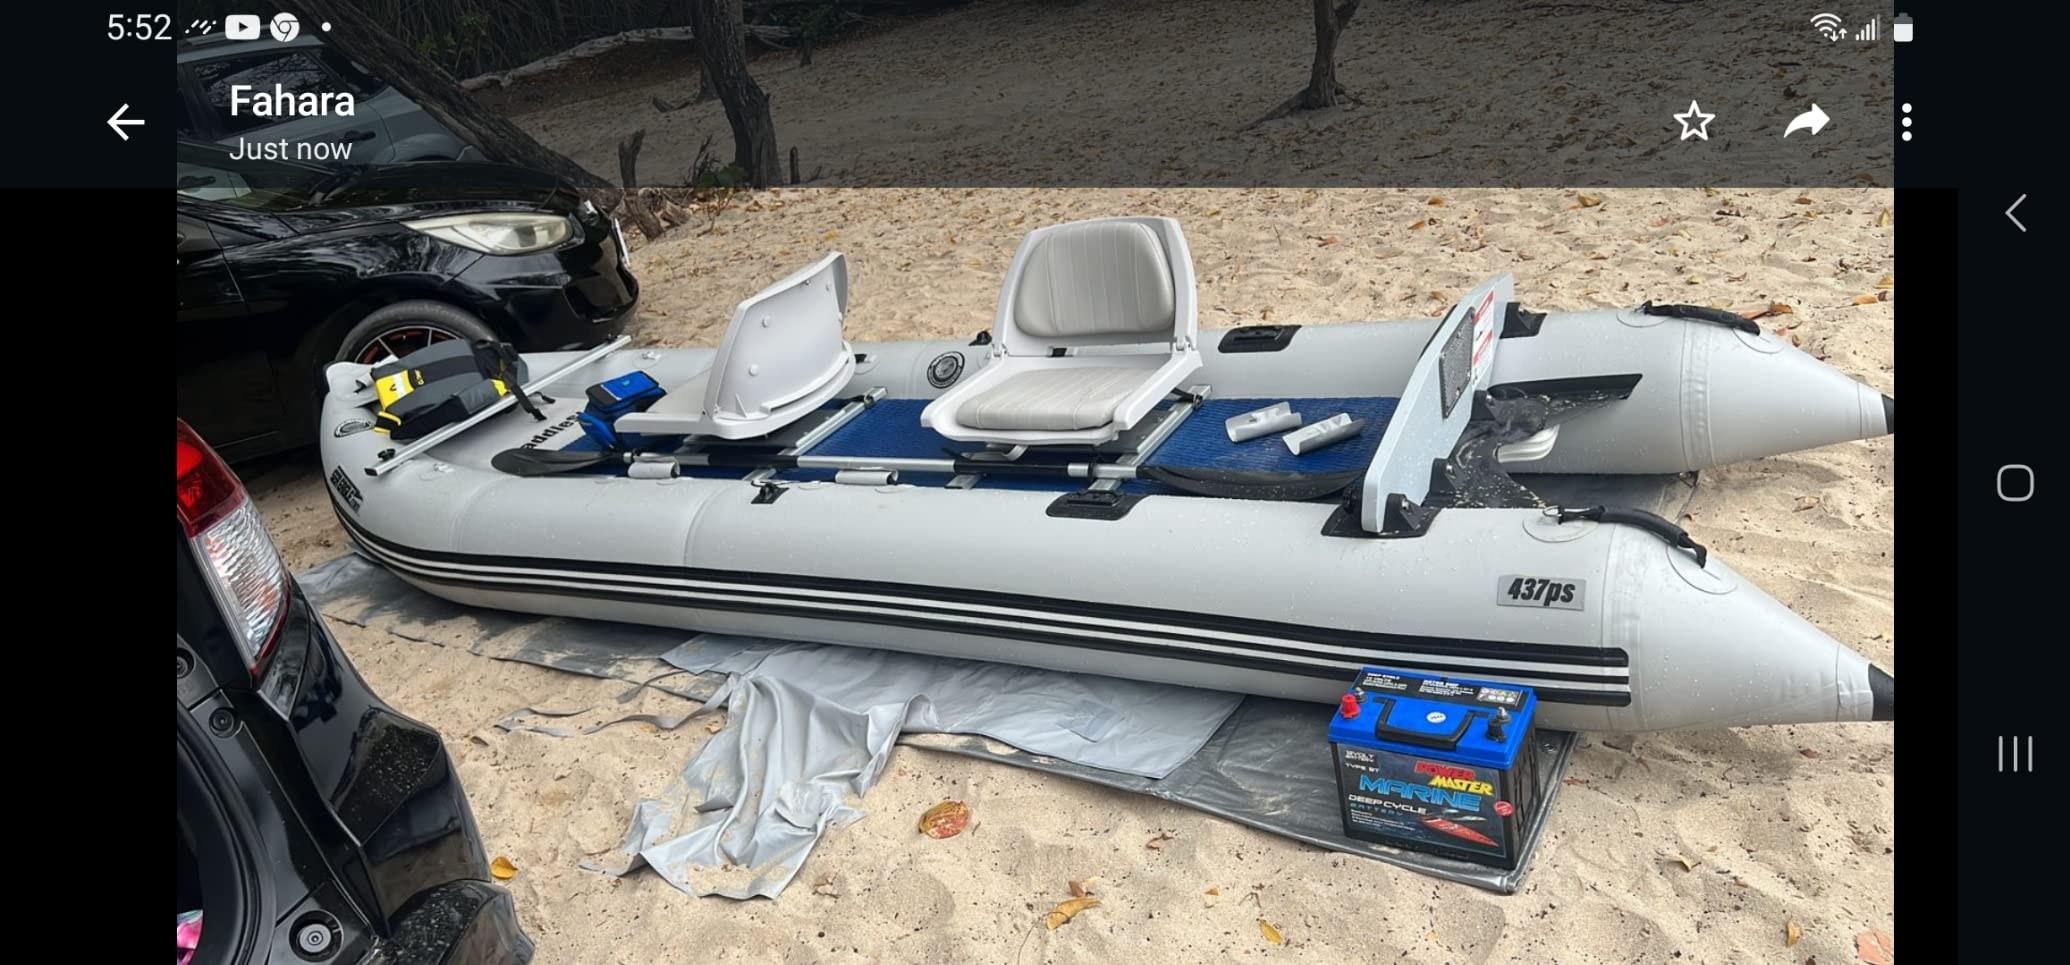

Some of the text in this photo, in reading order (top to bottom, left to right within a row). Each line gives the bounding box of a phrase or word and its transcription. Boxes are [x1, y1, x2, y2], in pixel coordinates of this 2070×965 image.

[1507, 577, 1576, 607] 437ps
[1415, 761, 1476, 780] POWER
[1359, 774, 1482, 812] MARINE
[1428, 775, 1494, 796] MASTER
[1348, 794, 1427, 815] DEEP CYCLE
